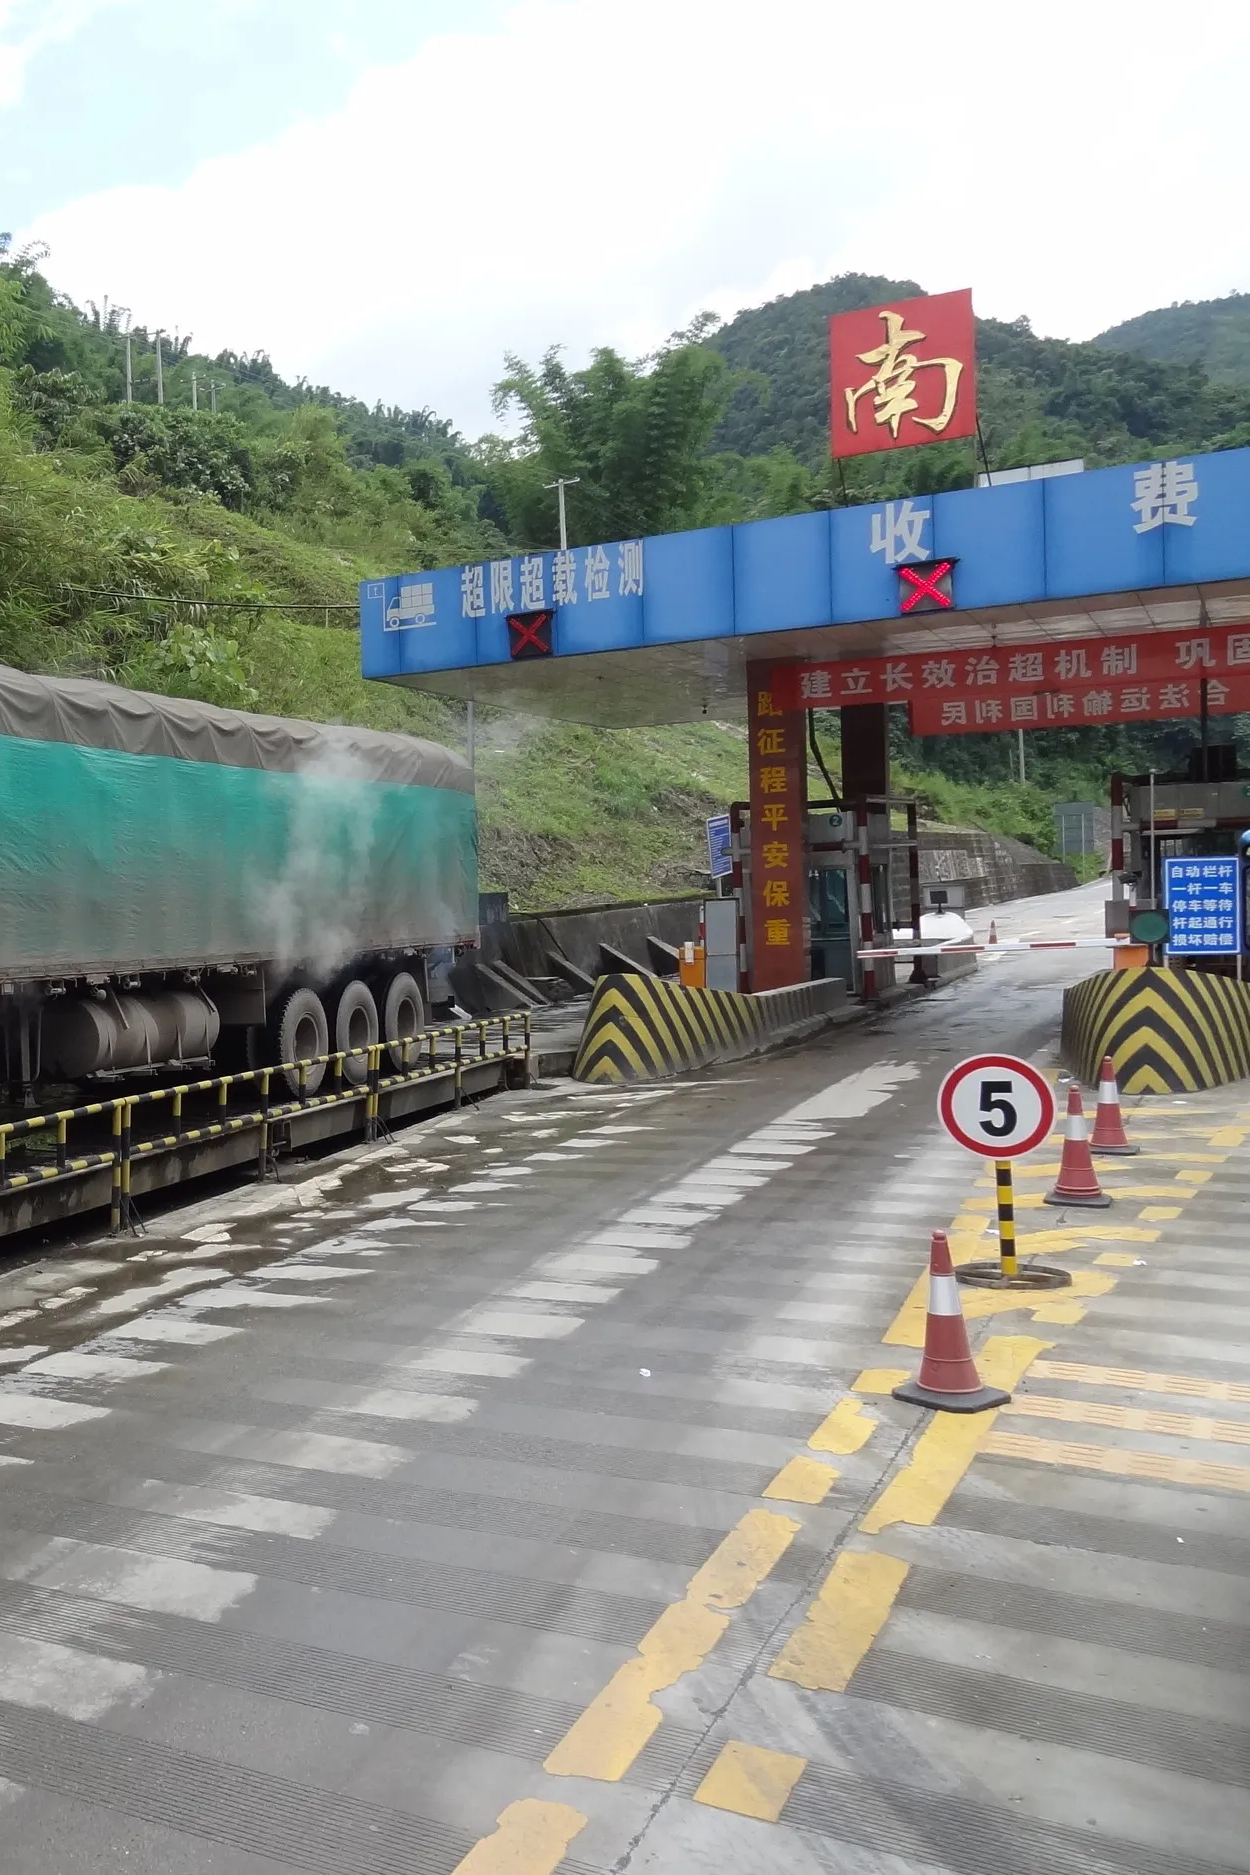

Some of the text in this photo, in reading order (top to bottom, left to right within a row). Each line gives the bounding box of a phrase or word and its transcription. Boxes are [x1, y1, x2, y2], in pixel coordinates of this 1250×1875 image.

[845, 311, 964, 439] 南
[869, 461, 1198, 564] 收 费
[461, 540, 644, 619] 超限超载检测
[801, 643, 1138, 699] 建立长效治超机制
[1171, 865, 1234, 878] 自动栏杆
[1171, 882, 1234, 895] 一杆一车
[1172, 899, 1233, 912] 停车等待
[1172, 916, 1234, 929] 杆起通行
[979, 1081, 1017, 1137] 5
